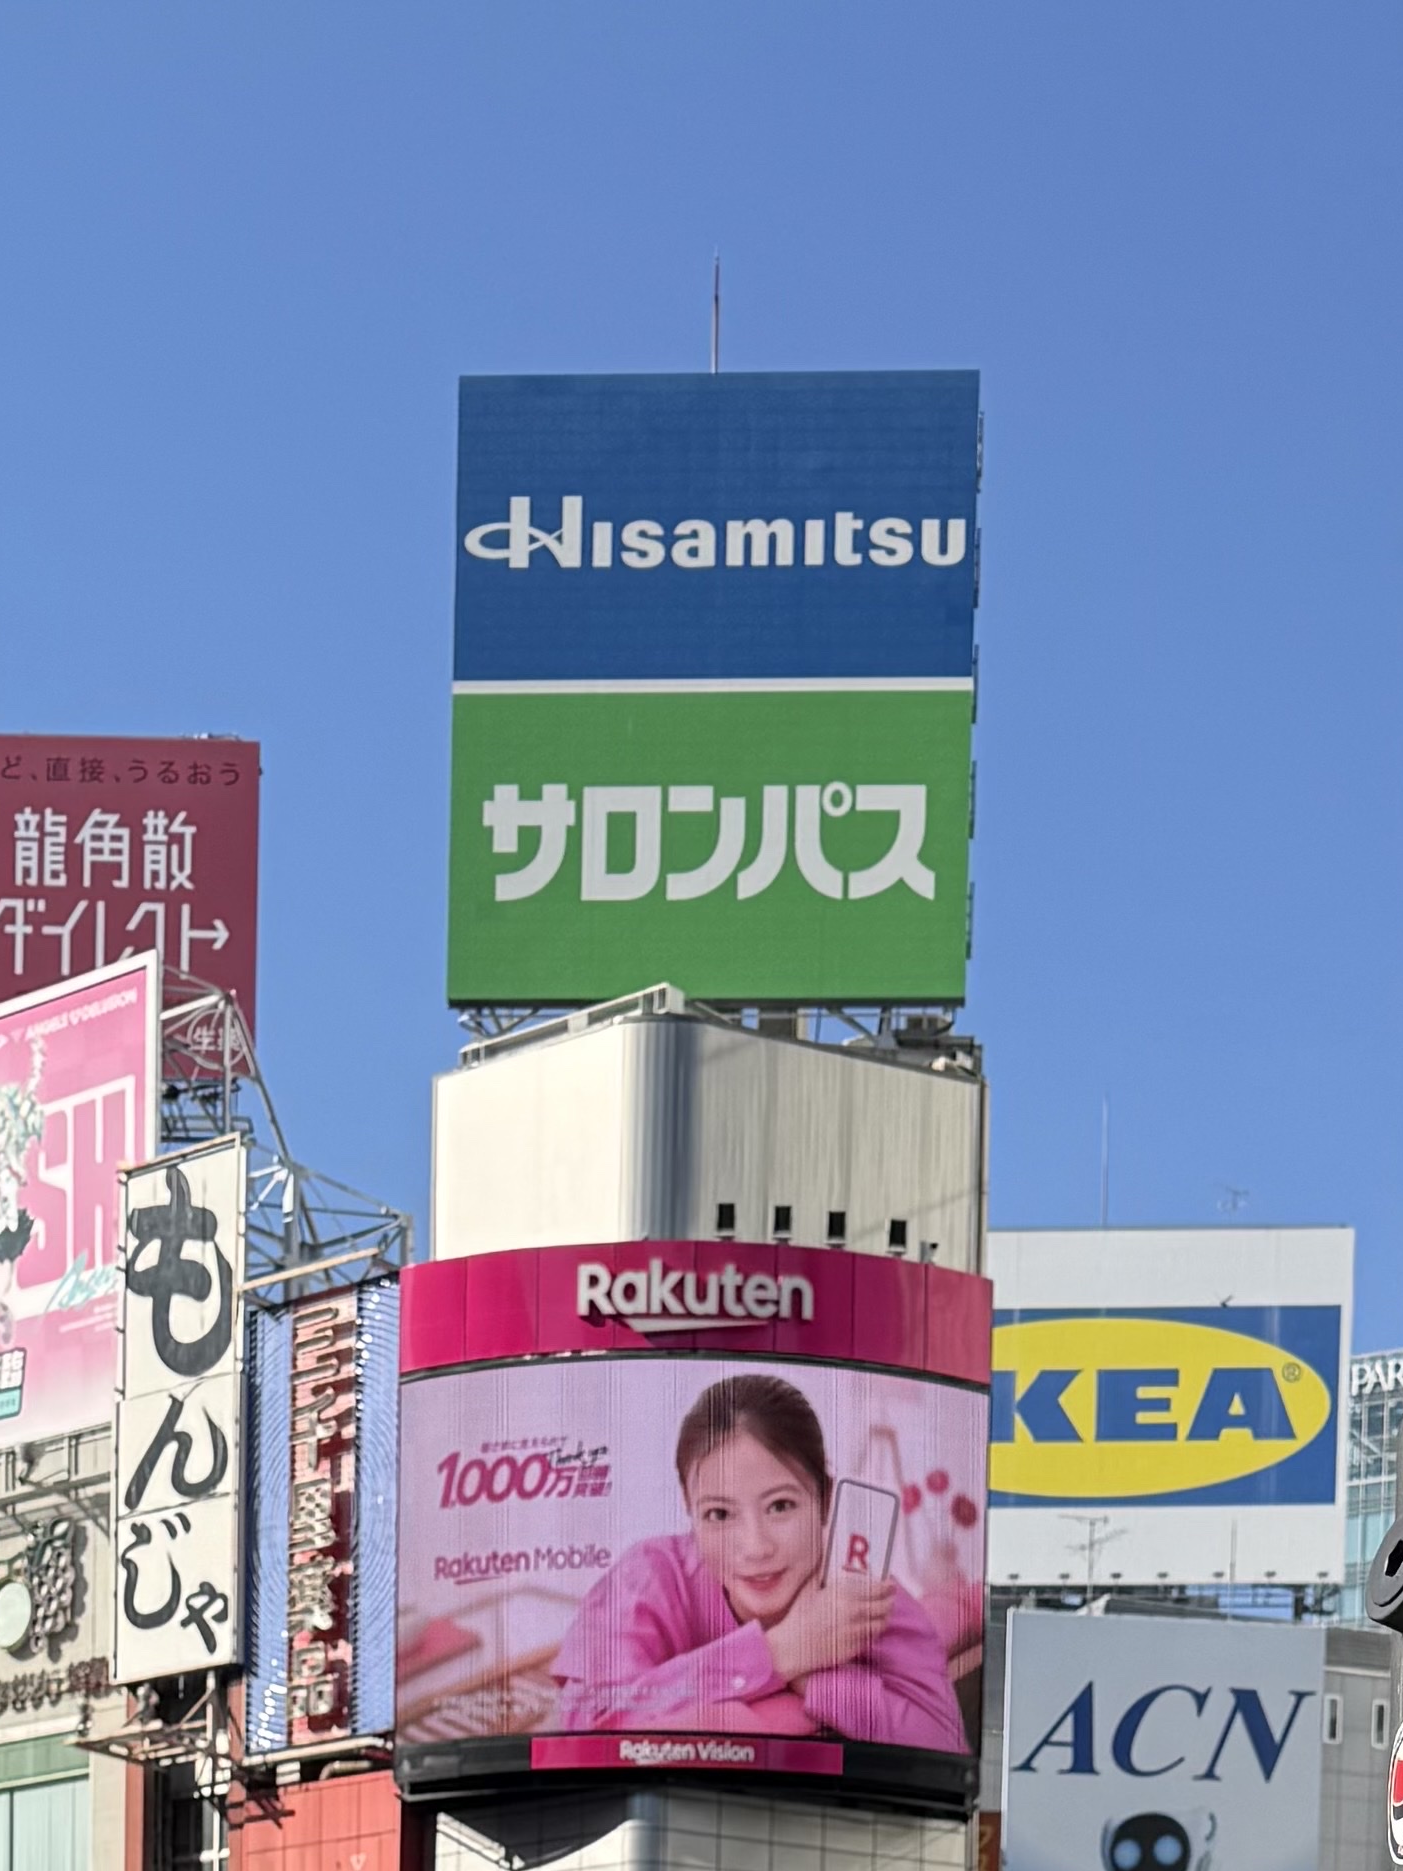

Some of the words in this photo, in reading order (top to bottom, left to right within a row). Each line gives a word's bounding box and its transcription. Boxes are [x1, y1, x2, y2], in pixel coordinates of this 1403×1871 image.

[464, 496, 966, 568] Hisamitsu
[13, 807, 198, 891] 龍角散
[482, 781, 936, 901] サロンパス
[577, 1259, 815, 1321] Rakuten
[125, 1165, 237, 1656] もんじゃ
[990, 1367, 1297, 1441] KEA
[434, 1552, 531, 1585] Rakuten
[533, 1543, 612, 1572] Mobile
[619, 1738, 693, 1765] Rakuten
[697, 1742, 755, 1764] Vision
[1011, 1681, 1316, 1783] ACN
